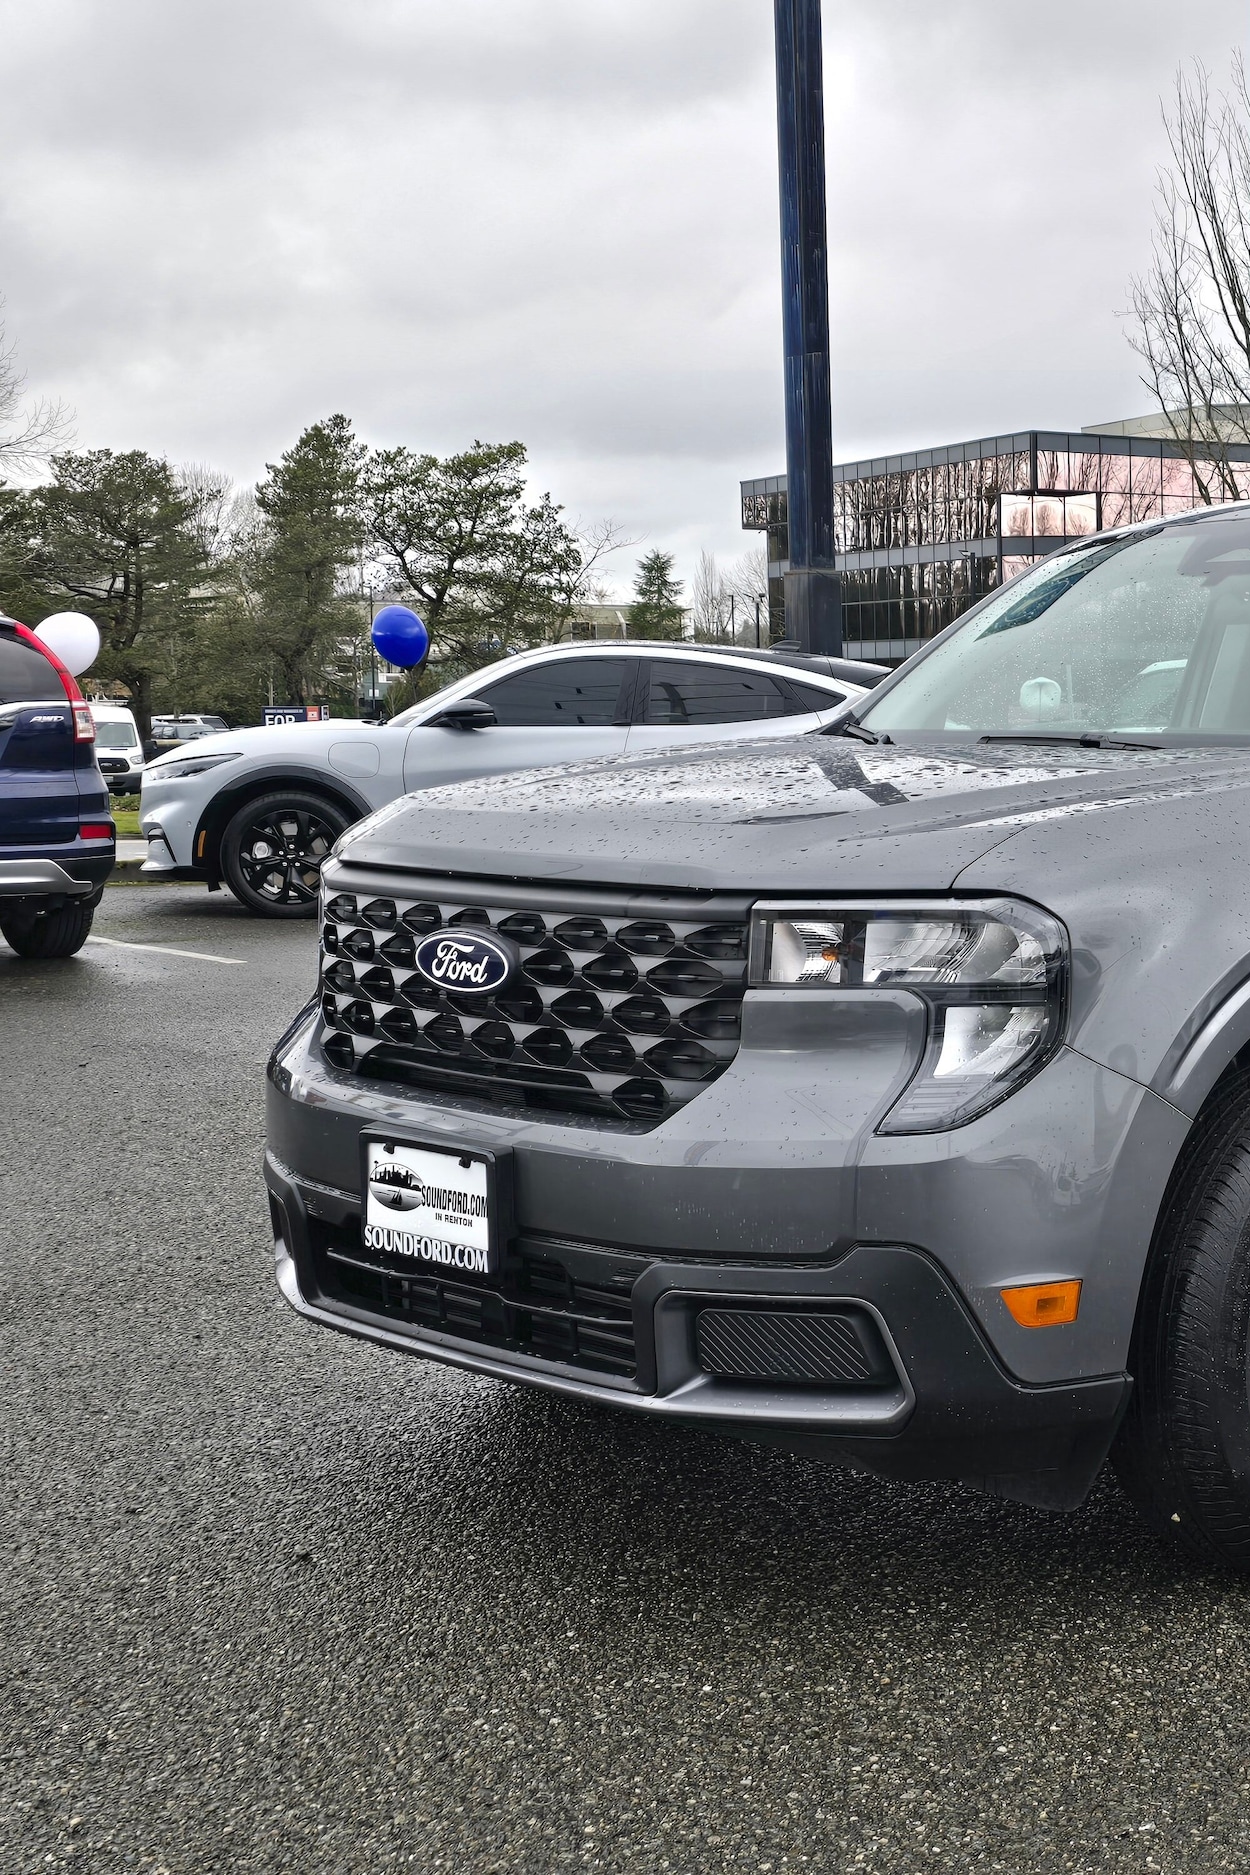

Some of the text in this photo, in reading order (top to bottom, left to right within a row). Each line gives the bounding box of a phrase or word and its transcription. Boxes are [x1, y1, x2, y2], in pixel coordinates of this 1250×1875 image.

[431, 940, 490, 984] Ford
[421, 1185, 489, 1219] SOUNDFORD.COM
[435, 1212, 473, 1228] IN RENTON
[364, 1224, 490, 1274] SOUNDFORD.COM
